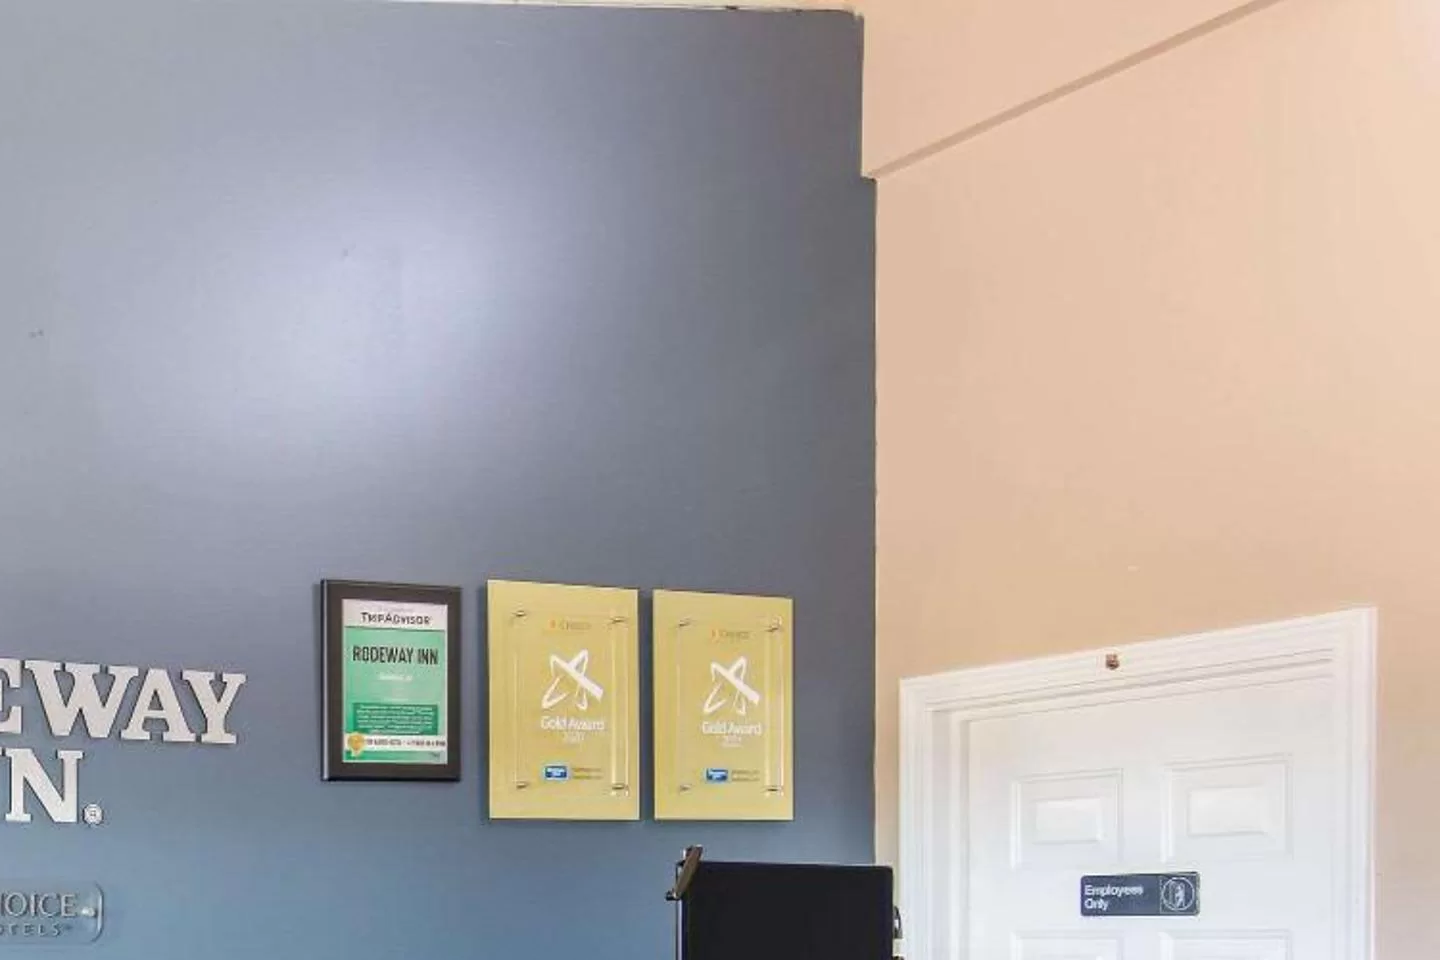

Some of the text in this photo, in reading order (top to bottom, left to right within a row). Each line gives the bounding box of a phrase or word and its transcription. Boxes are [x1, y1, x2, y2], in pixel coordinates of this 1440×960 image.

[352, 645, 439, 665] RODEWAY INN
[541, 715, 605, 730] Gold Award
[1084, 884, 1144, 897] Employees
[1084, 898, 1109, 911] Only
